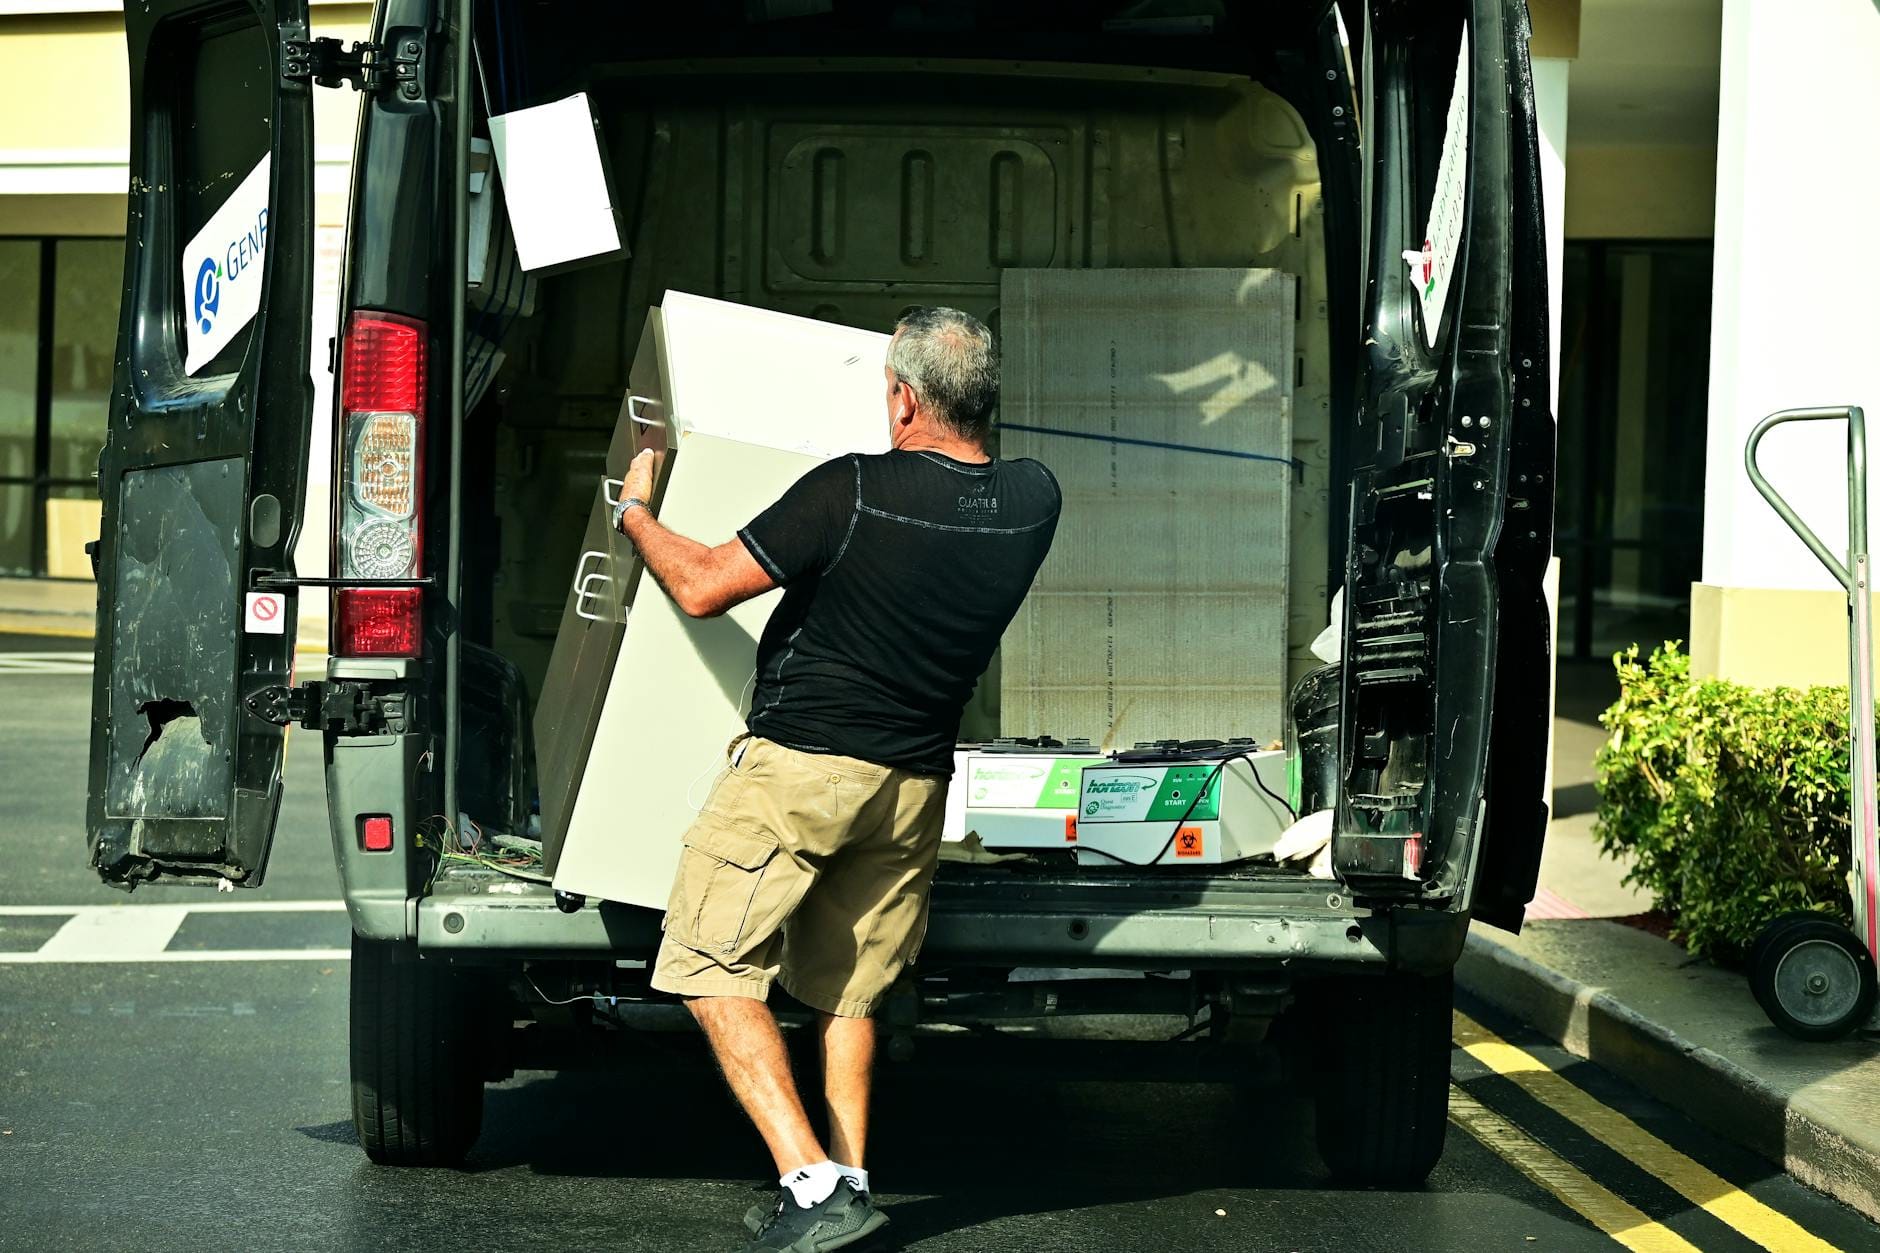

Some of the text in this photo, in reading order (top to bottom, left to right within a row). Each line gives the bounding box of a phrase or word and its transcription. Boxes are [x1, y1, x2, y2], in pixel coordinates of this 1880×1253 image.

[1432, 95, 1466, 249] Laboratorio
[1438, 180, 1463, 281] Buena
[1086, 778, 1141, 794] horizon
